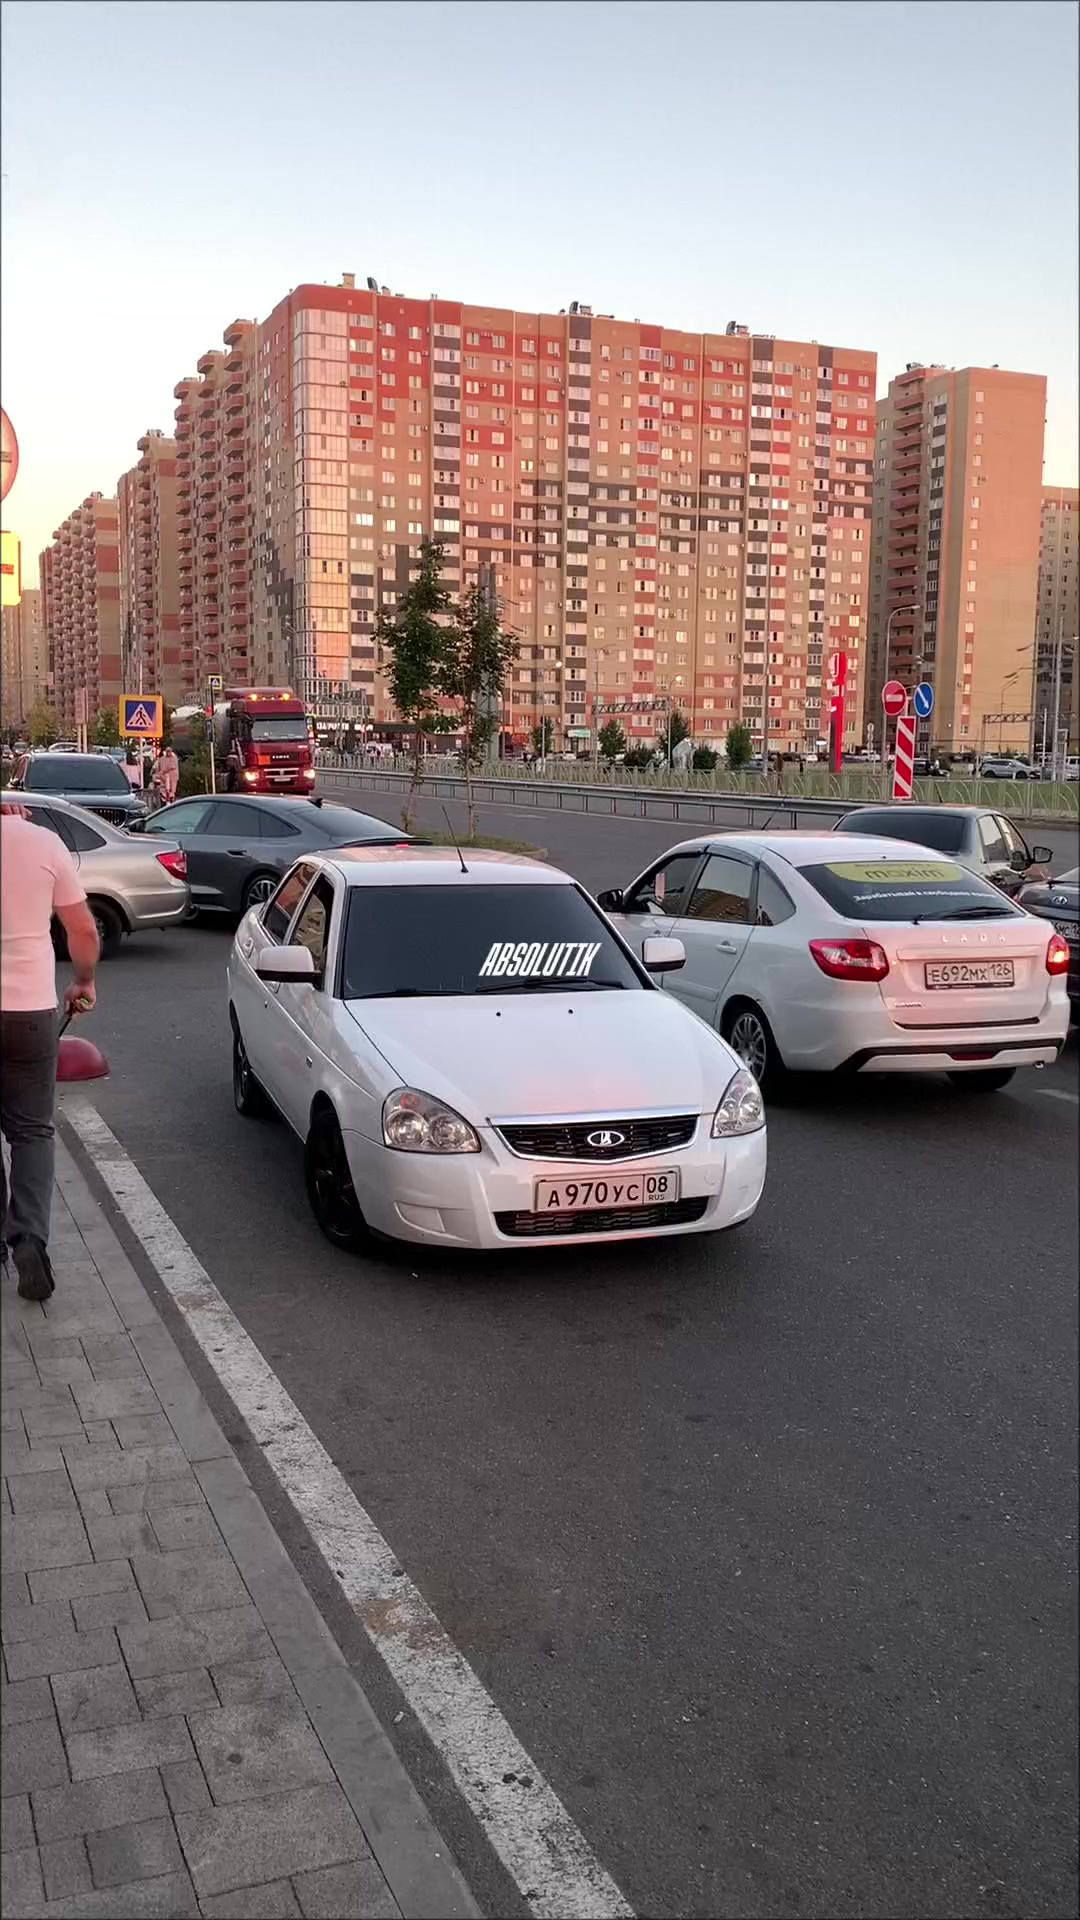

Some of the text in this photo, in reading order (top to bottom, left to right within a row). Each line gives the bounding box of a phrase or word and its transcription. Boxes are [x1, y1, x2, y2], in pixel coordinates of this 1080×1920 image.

[865, 868, 944, 879] maxim
[942, 934, 1006, 943] LADA
[478, 942, 603, 977] ABSOLUTIK
[647, 1176, 668, 1194] 08
